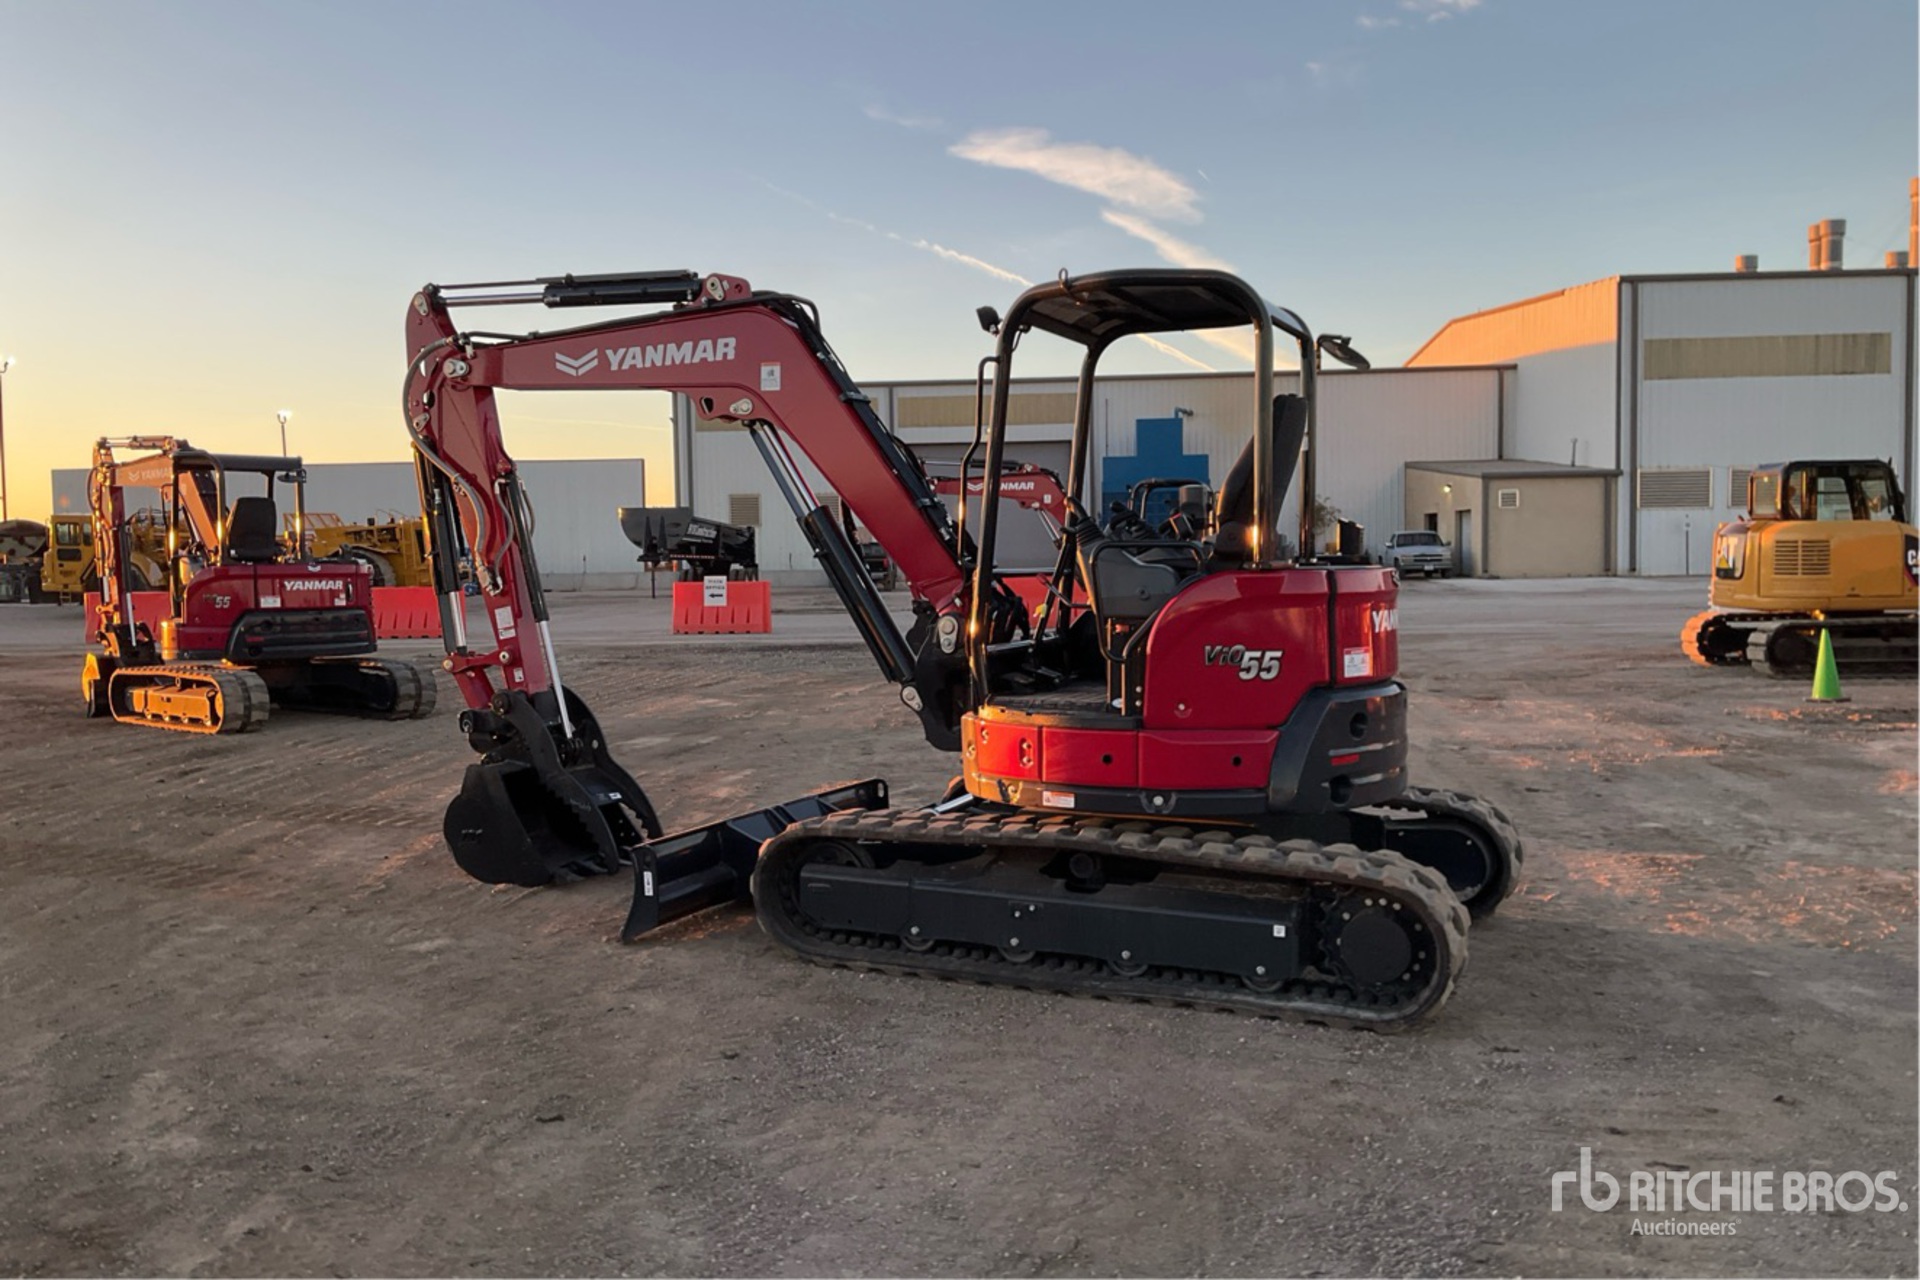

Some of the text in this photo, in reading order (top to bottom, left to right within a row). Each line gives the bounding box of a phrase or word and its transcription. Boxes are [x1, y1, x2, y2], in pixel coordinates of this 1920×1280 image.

[605, 336, 737, 371] YANMAR
[1000, 481, 1035, 491] NMAR
[284, 580, 343, 591] YANMAR
